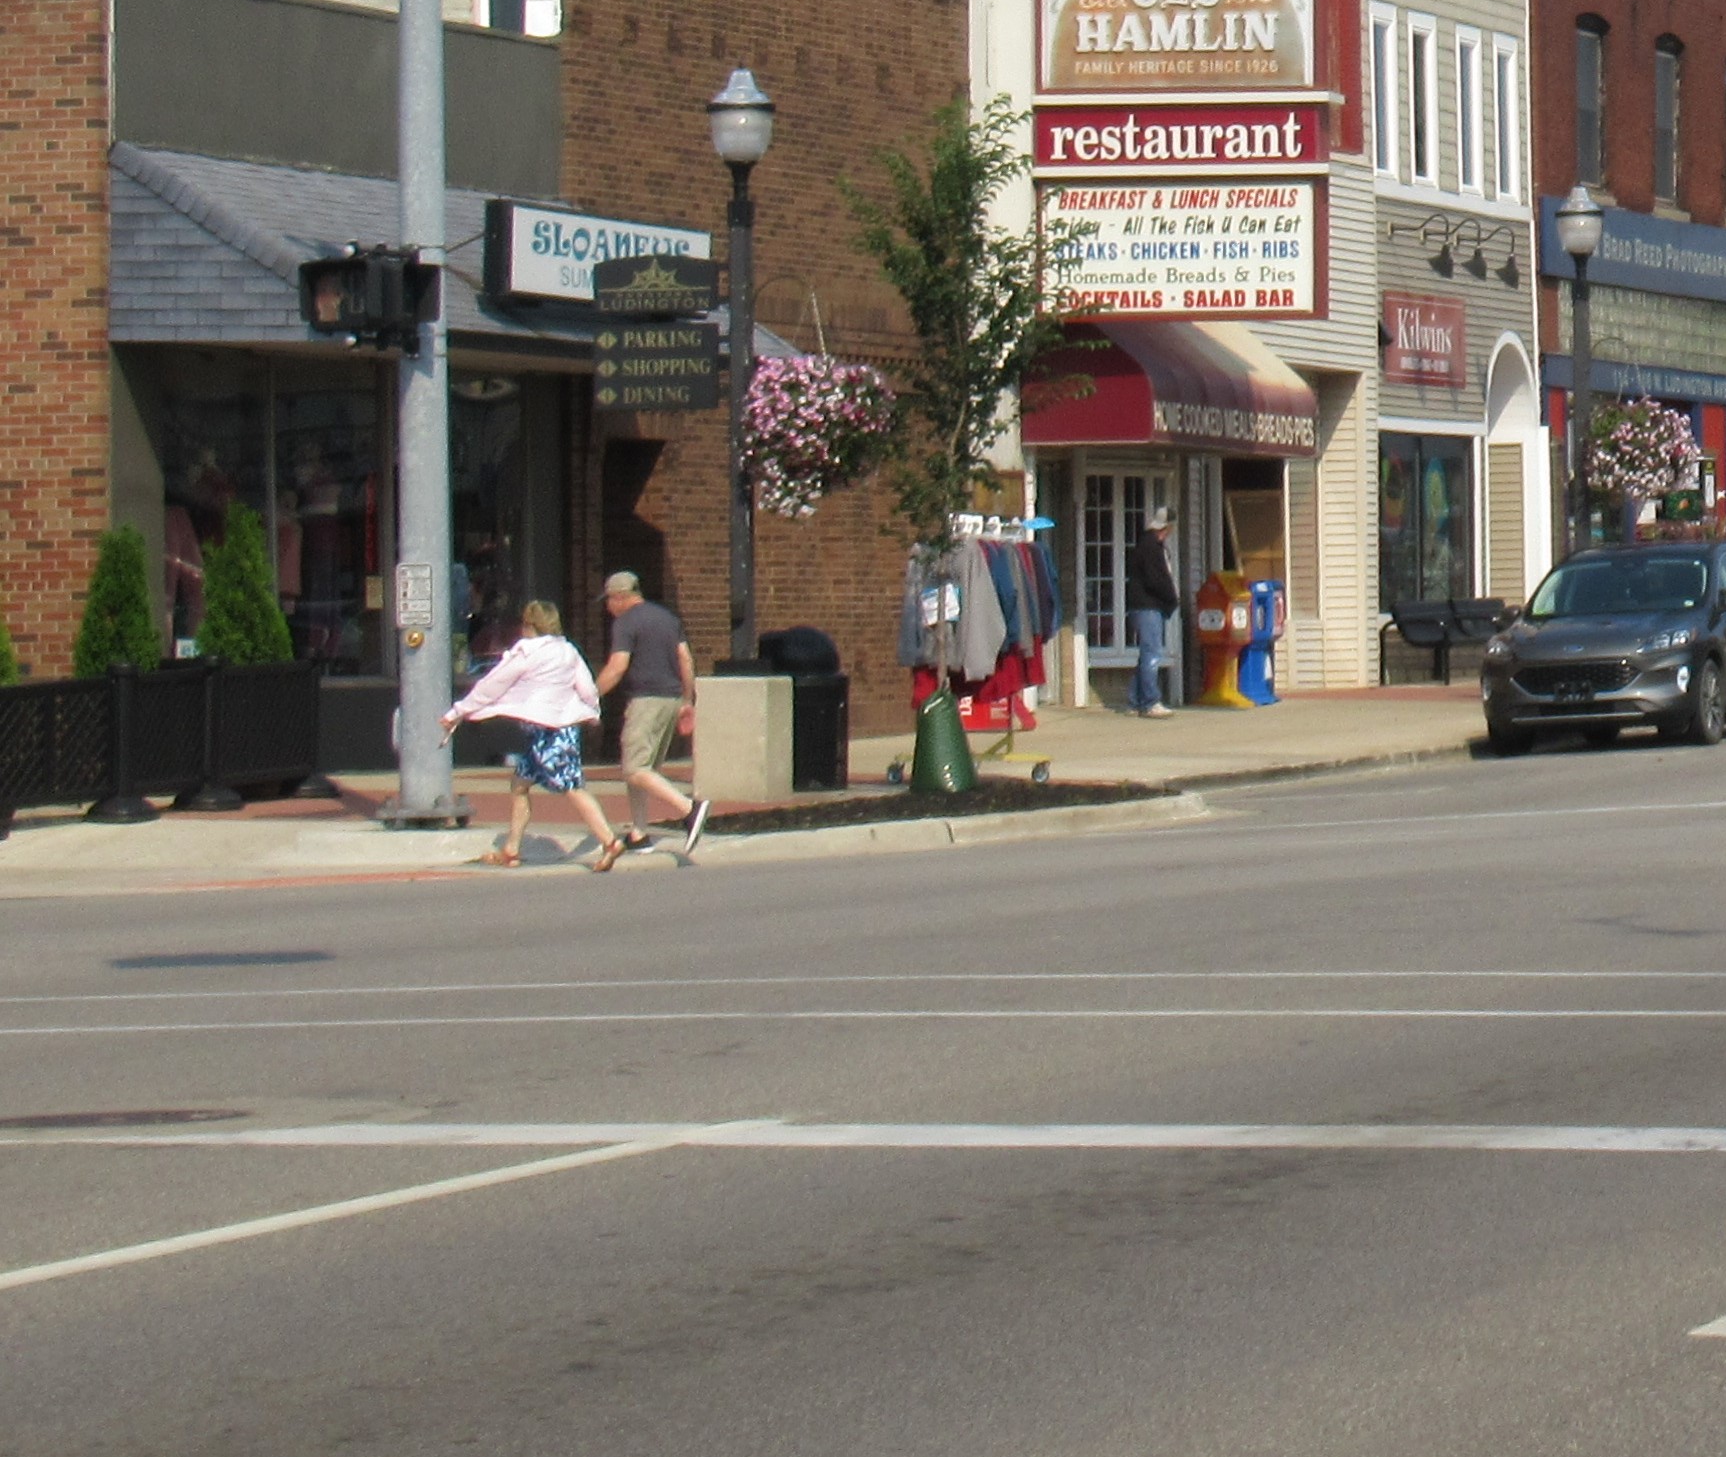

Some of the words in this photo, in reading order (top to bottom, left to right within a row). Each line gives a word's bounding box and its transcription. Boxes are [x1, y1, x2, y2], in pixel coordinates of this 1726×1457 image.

[1075, 12, 1278, 52] HAMLIN
[1075, 61, 1124, 75] FAMILY
[1129, 60, 1194, 74] HERITAGE
[1200, 60, 1241, 74] SINCE
[1247, 59, 1278, 73] 1926
[1050, 112, 1302, 160] restaurant
[1058, 190, 1147, 210] BREAKFAST
[1152, 189, 1163, 210] &
[1170, 189, 1219, 209] LUNCH
[1225, 188, 1298, 208] SPECIALS
[1053, 218, 1101, 240] riday
[1123, 216, 1143, 234] All
[1151, 216, 1176, 234] The
[1184, 216, 1215, 234] Fish
[1222, 216, 1231, 234] U
[1239, 216, 1266, 234] Can
[1274, 215, 1302, 234] Eat
[1055, 242, 1118, 260] STEAKS
[1131, 242, 1200, 260] CHICKEN
[1214, 241, 1249, 260] FISH
[1262, 241, 1300, 259] RIBS
[1058, 267, 1157, 284] Homemade
[1166, 267, 1226, 283] Breads
[1235, 268, 1249, 283] &
[1260, 266, 1295, 282] Pies
[601, 297, 709, 311] LUDINGTON
[1184, 290, 1246, 308] SALAD
[1256, 289, 1295, 307] BAR
[624, 330, 702, 348] PARKING
[1398, 307, 1452, 354] Kilwins
[623, 358, 711, 376] SHOPPING
[624, 386, 690, 404] DINING
[1154, 400, 1182, 433] HOME
